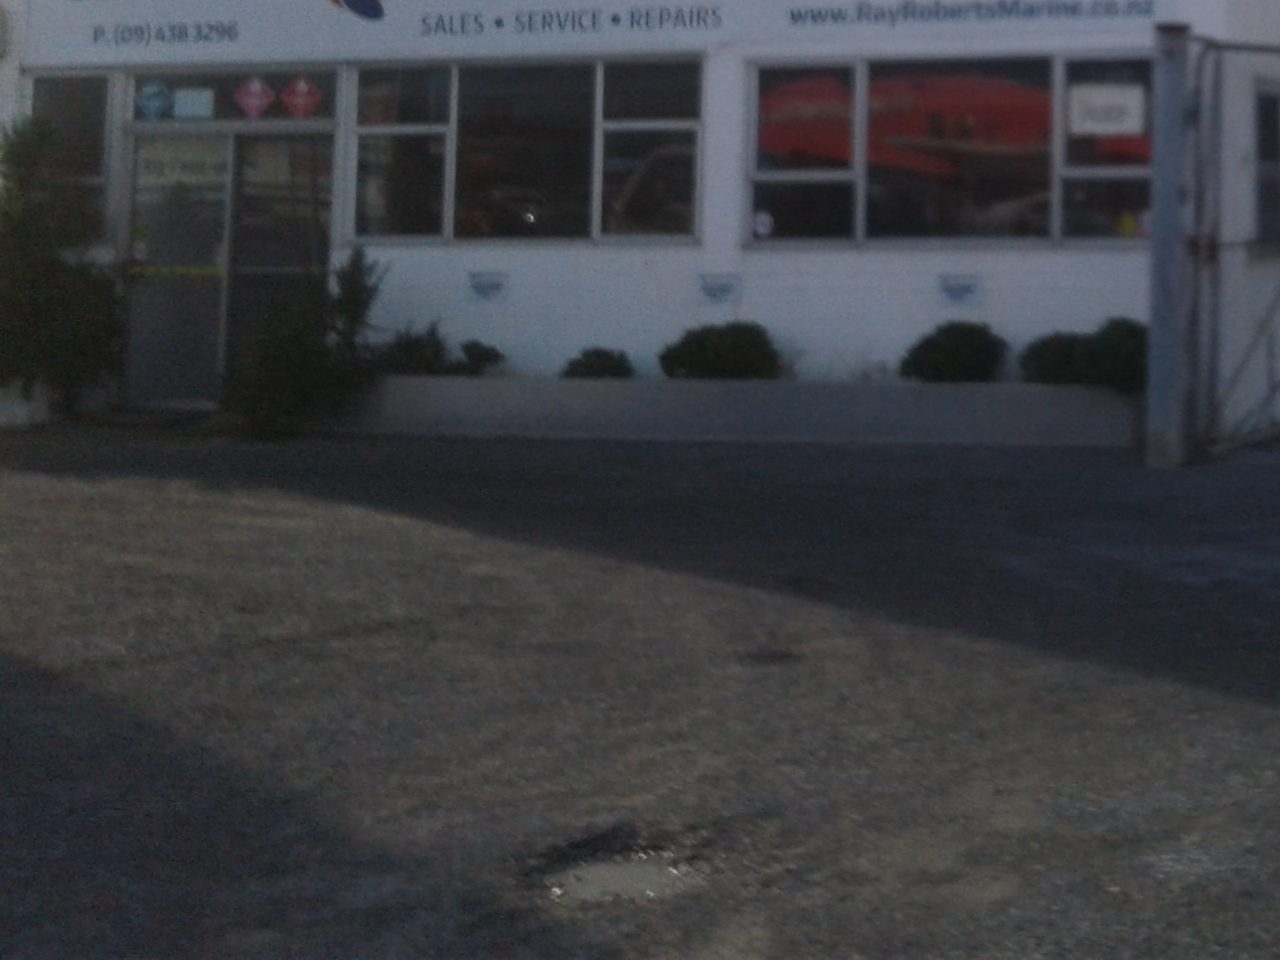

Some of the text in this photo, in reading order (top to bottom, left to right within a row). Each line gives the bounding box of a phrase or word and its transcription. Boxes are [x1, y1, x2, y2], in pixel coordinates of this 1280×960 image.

[420, 4, 723, 37] SALES SERVICE REPAIRS
